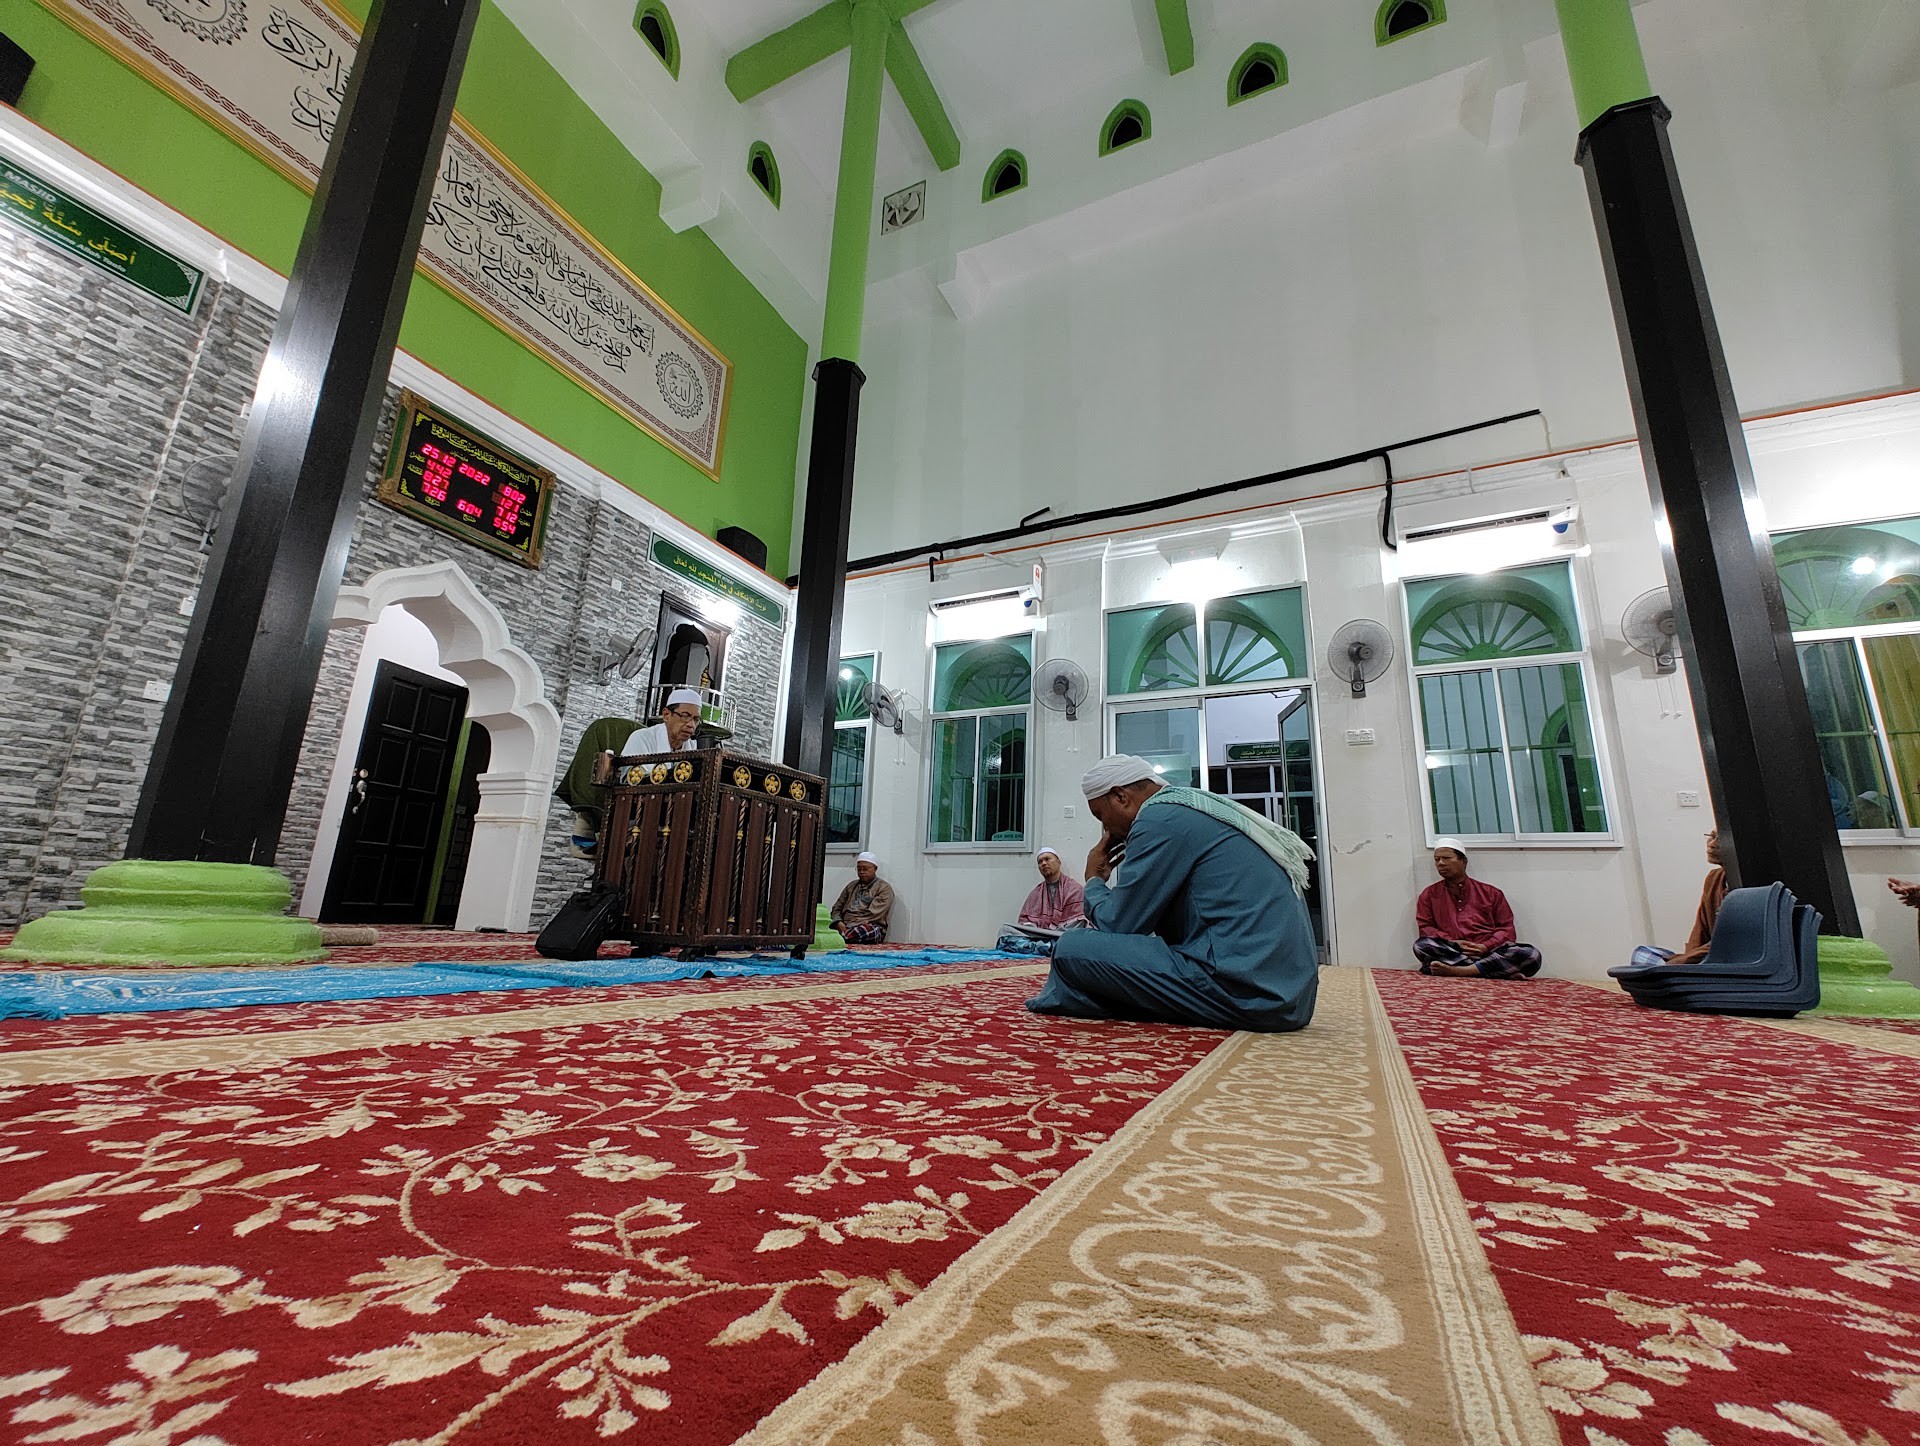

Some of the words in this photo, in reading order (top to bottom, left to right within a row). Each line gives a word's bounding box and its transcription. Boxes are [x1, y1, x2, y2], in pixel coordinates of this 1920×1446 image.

[4, 171, 57, 202] MASJID
[76, 243, 102, 260] Allah
[422, 444, 440, 459] 25
[441, 454, 456, 467] 12
[458, 463, 490, 485] 2022
[427, 459, 452, 478] 442
[423, 470, 449, 489] 827
[423, 481, 446, 501] 726
[502, 486, 526, 504] 802
[457, 499, 482, 517] 604
[493, 517, 516, 534] 554
